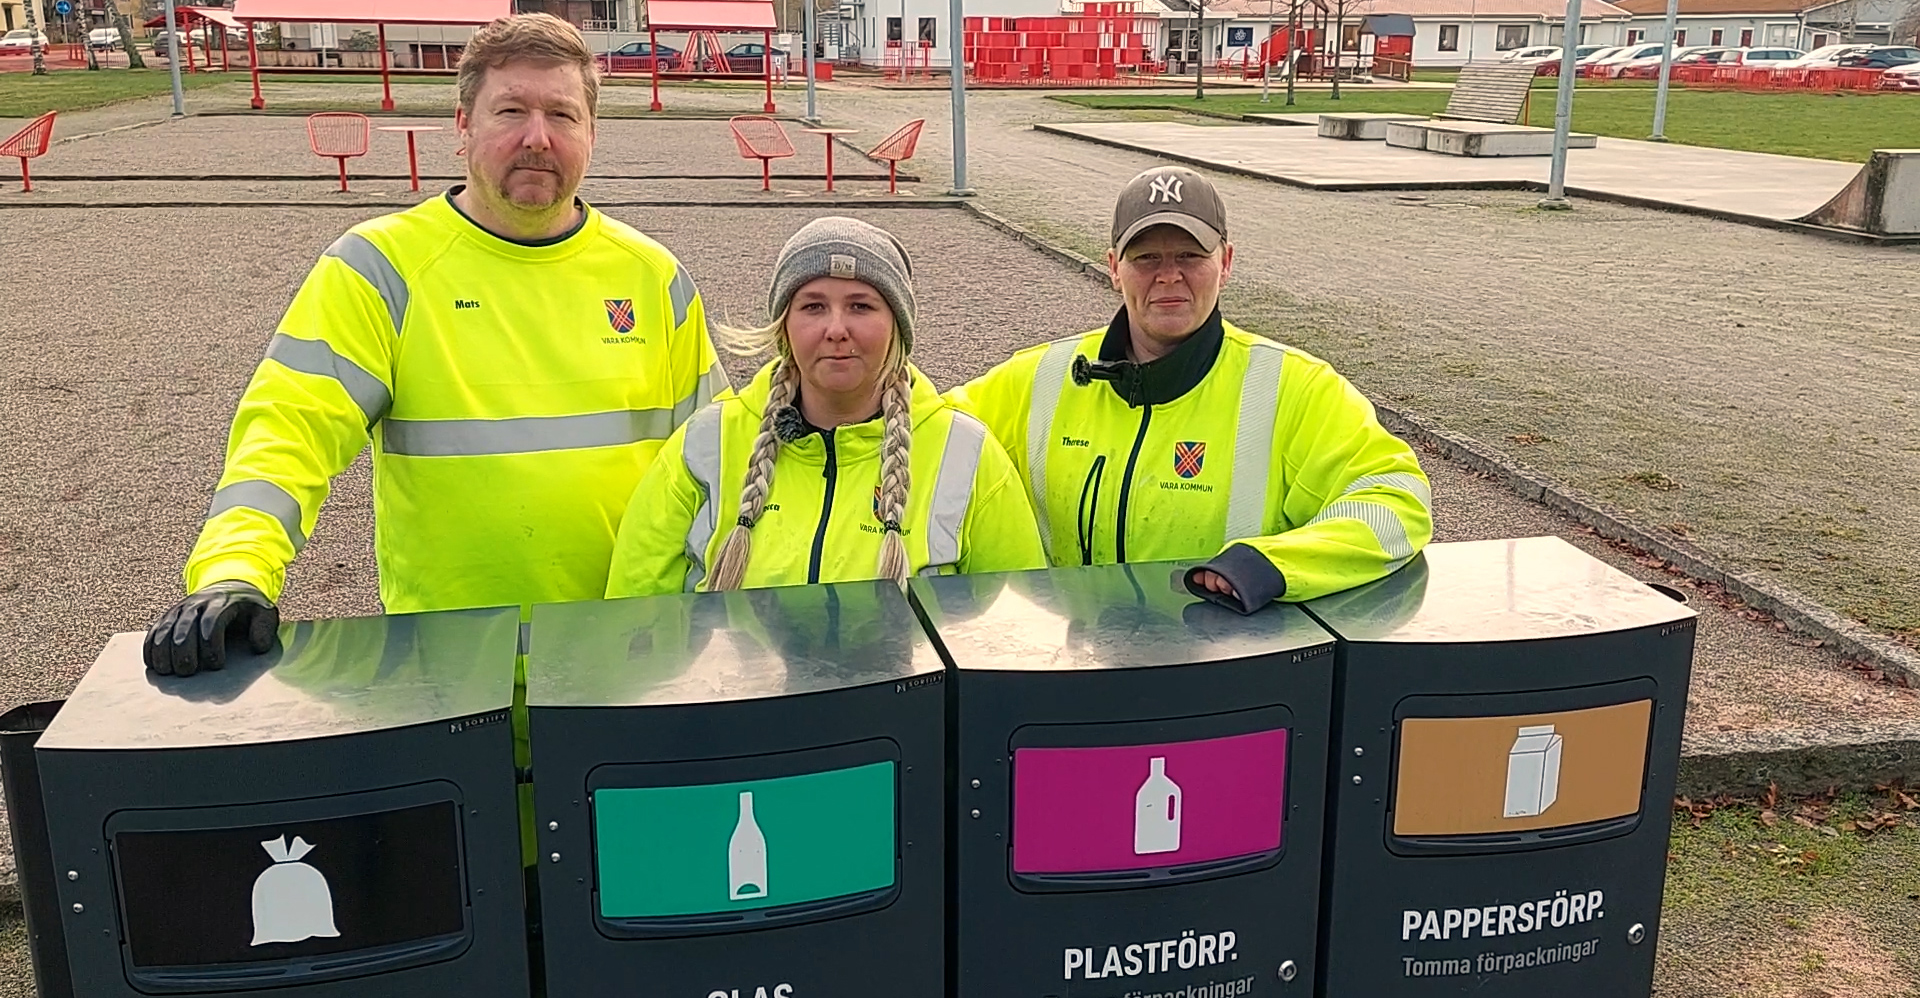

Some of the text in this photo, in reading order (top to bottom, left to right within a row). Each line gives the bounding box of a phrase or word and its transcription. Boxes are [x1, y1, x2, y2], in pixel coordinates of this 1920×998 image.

[1149, 174, 1184, 204] NY
[455, 300, 480, 309] Mats
[1062, 436, 1090, 448] Therese
[1160, 481, 1214, 493] VARA KOMMUN
[860, 523, 878, 534] VARA
[1402, 889, 1604, 941] PAPPERSFÖRP.
[1063, 930, 1239, 980] PLASTFÖRP.
[1403, 938, 1600, 977] Tomma förpackningar
